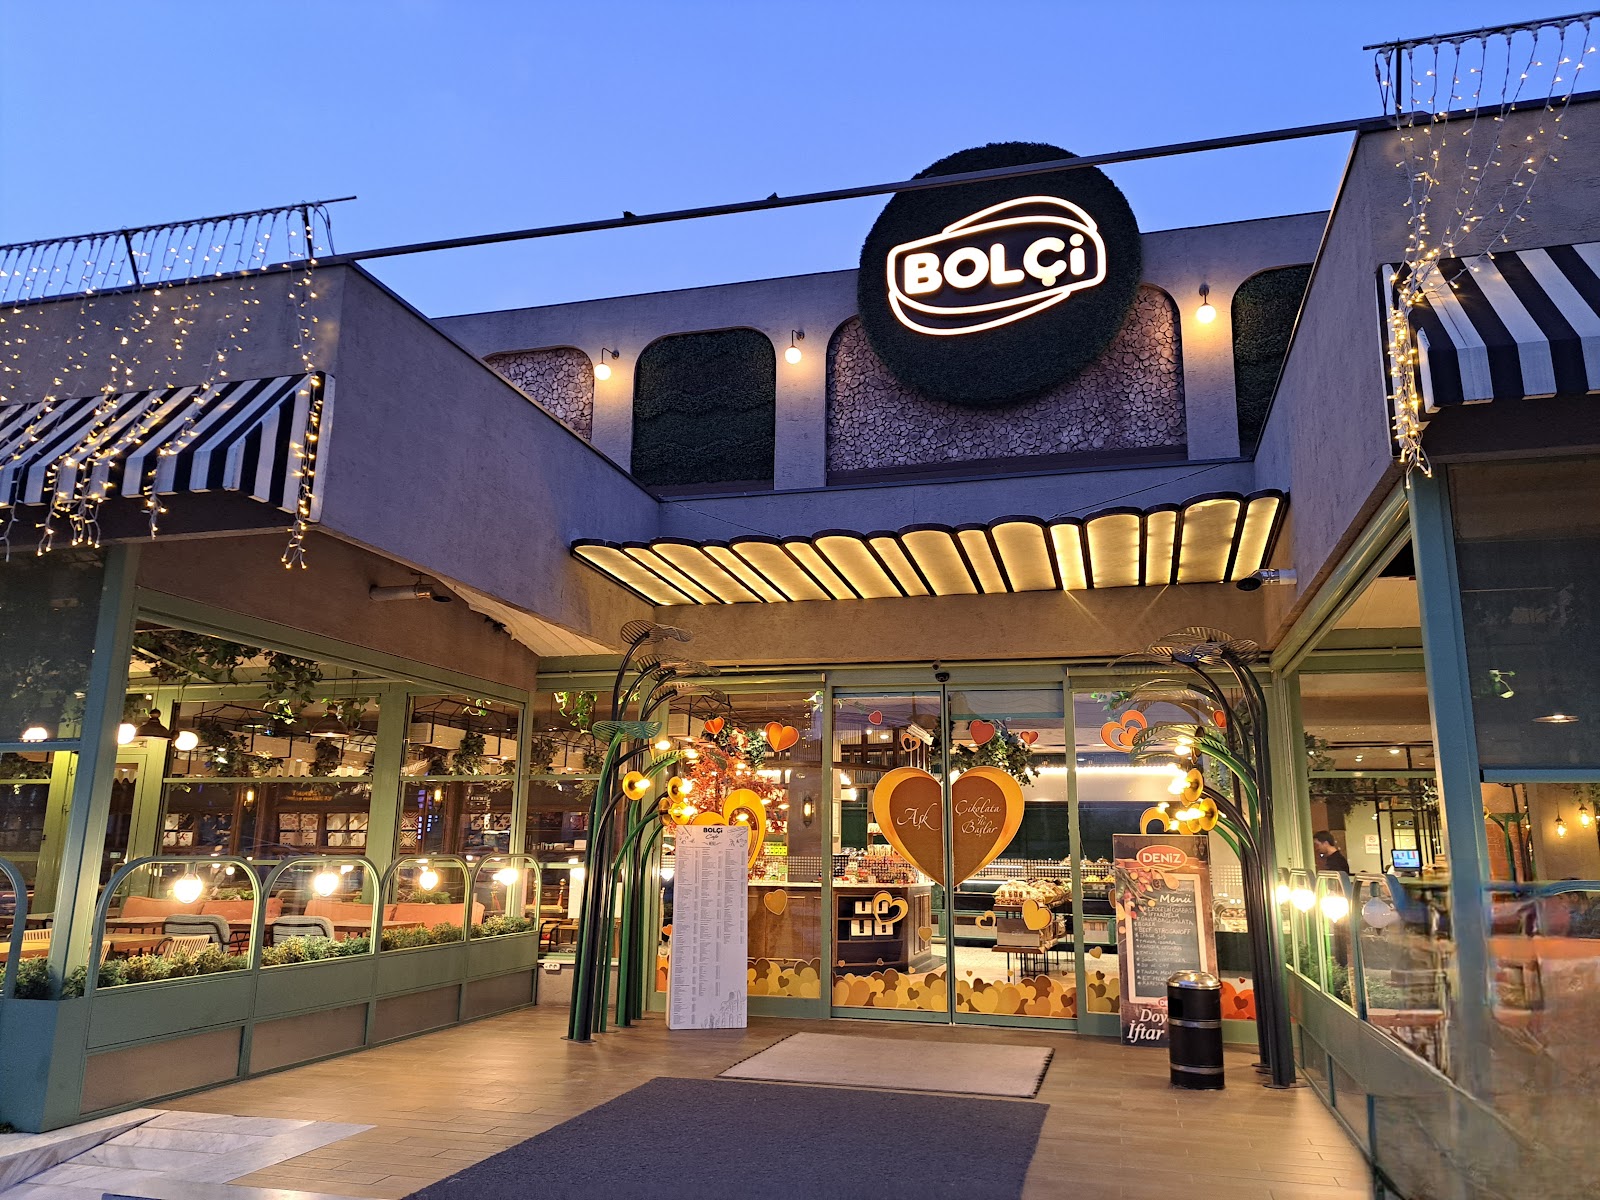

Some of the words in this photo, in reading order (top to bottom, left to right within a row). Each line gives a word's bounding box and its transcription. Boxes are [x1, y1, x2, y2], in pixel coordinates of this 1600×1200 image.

[896, 803, 940, 831] Aşk
[955, 796, 1001, 818] Çikolata
[961, 820, 998, 837] Başlar
[1160, 894, 1192, 903] Menü
[1127, 1020, 1165, 1043] İftar
